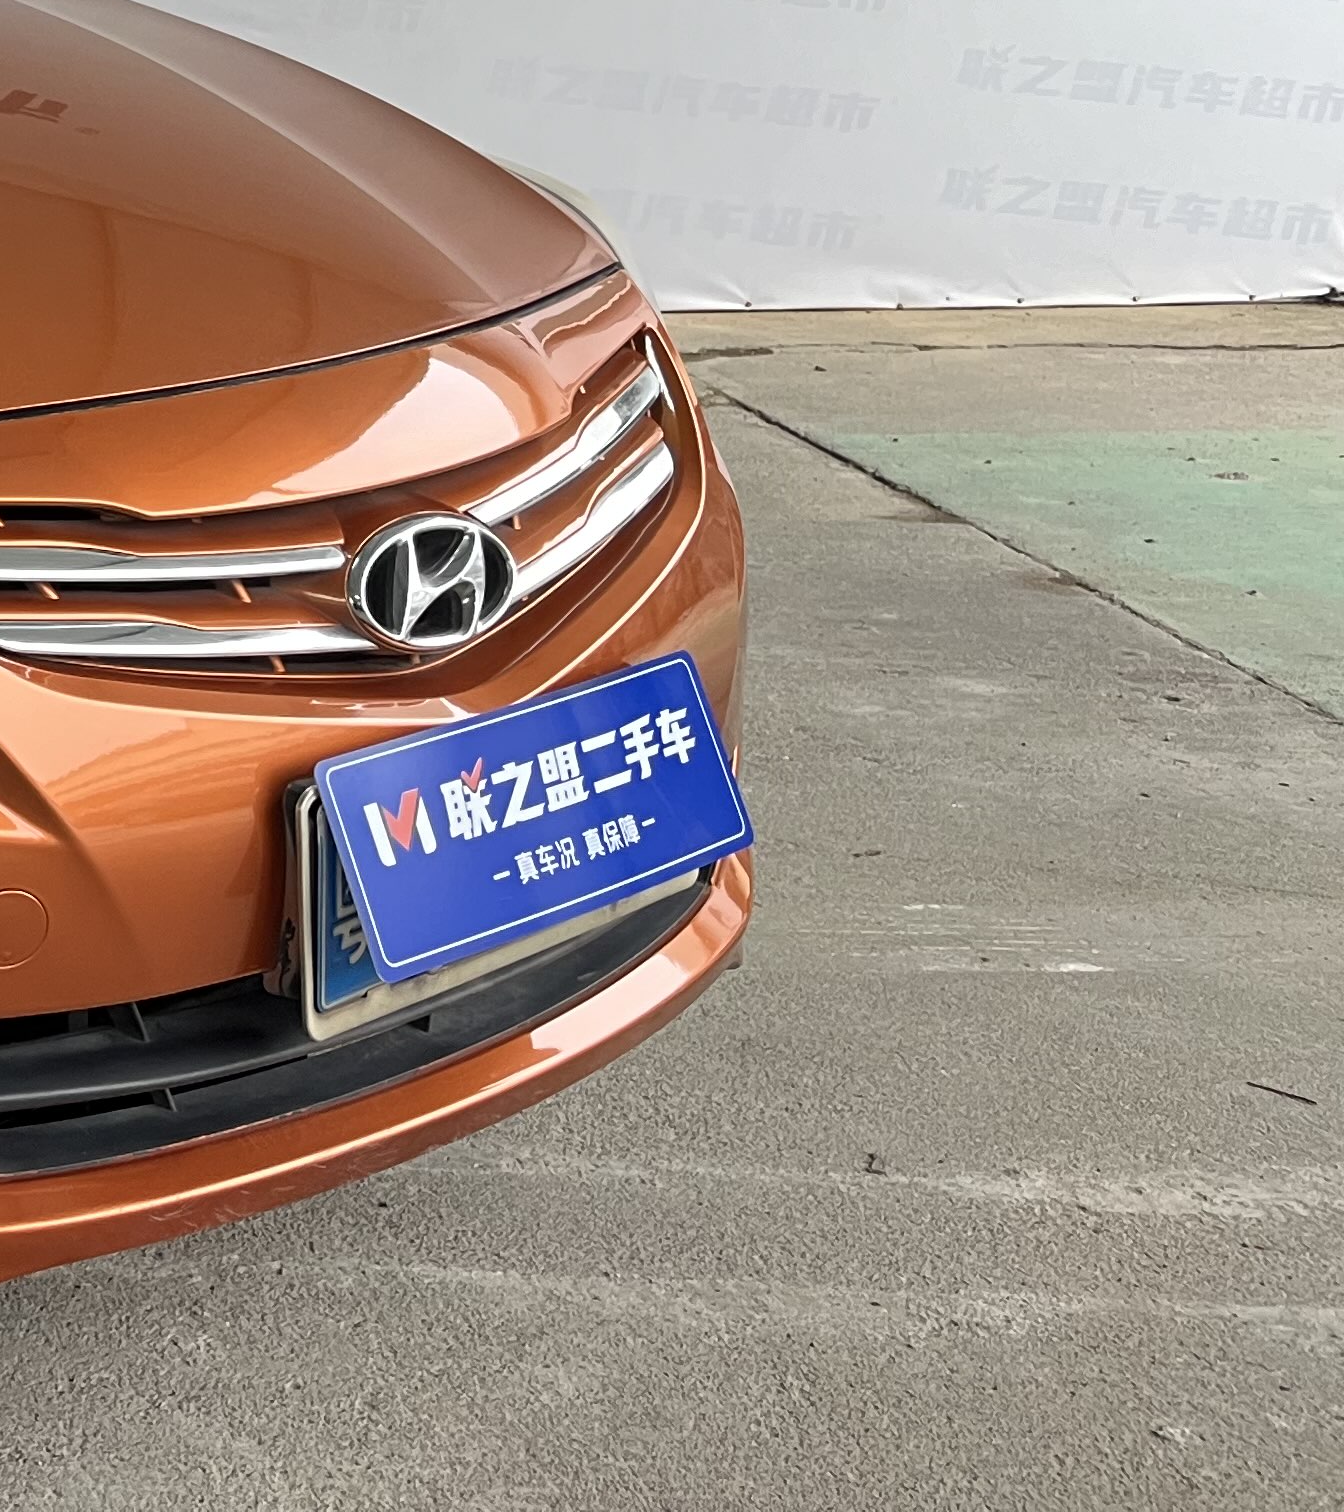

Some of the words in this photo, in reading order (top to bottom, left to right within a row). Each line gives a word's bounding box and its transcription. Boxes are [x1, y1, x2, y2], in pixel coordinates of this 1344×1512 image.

[939, 164, 1333, 245] 联之盟汽车超市
[440, 706, 698, 841] 联之盟二手车
[514, 837, 580, 886] 真车况
[582, 813, 641, 860] 真保障
